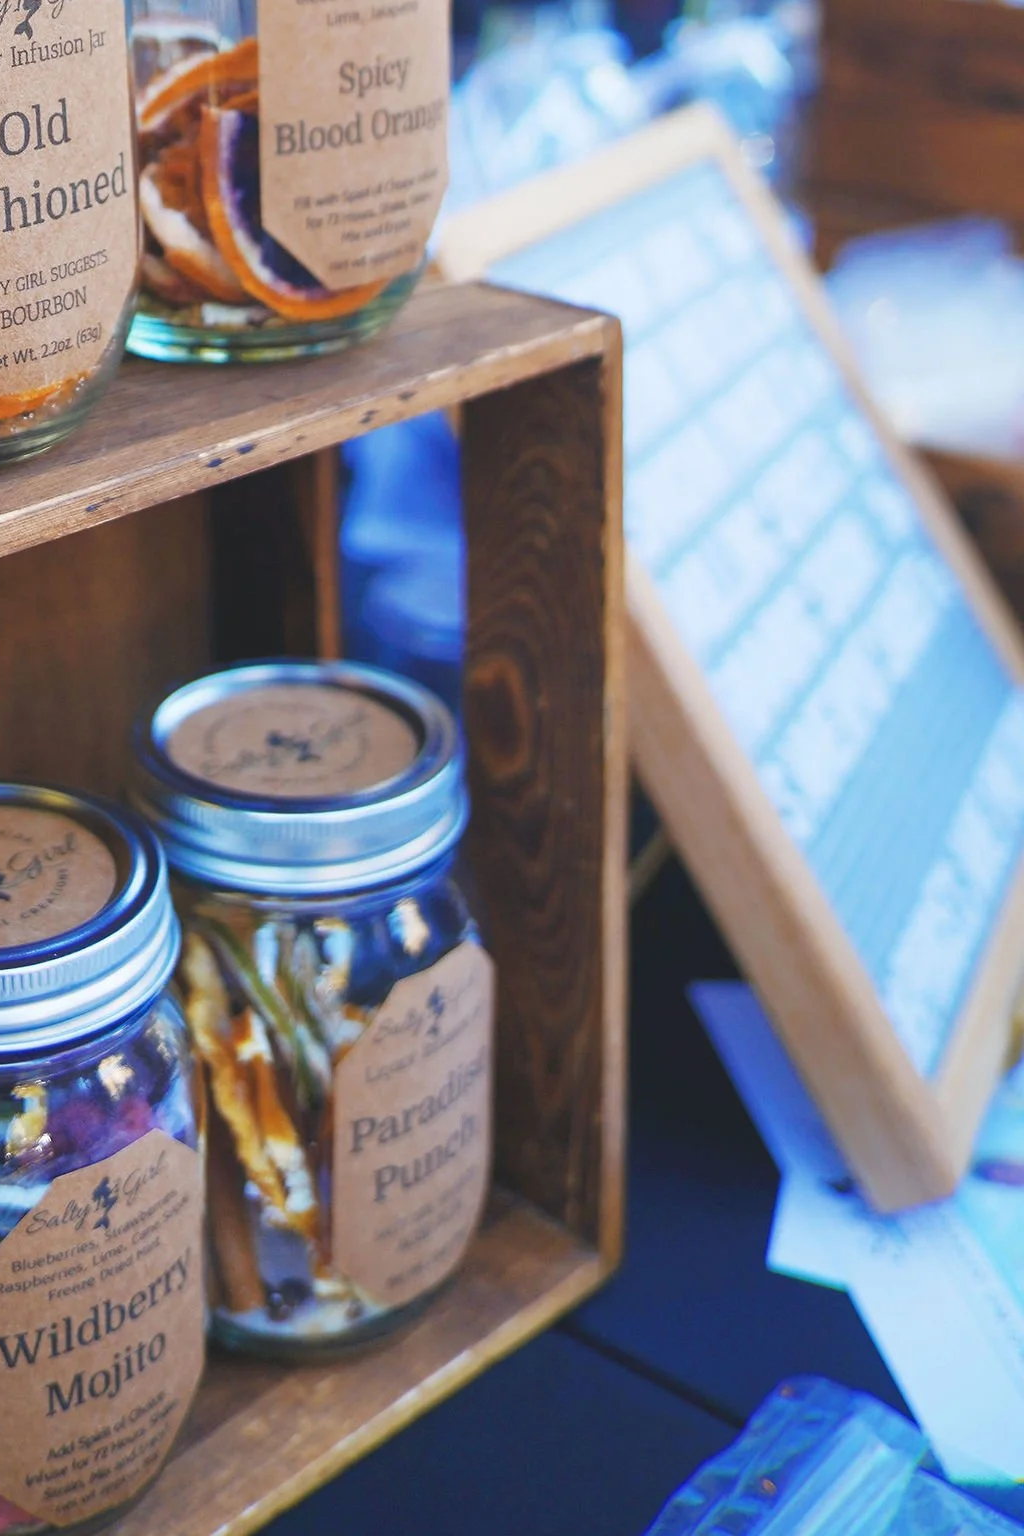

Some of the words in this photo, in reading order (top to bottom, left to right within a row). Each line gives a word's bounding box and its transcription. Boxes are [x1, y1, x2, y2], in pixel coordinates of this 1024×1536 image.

[10, 36, 85, 69] Infusion
[88, 28, 107, 56] Jar
[338, 55, 412, 99] Spicy
[274, 111, 364, 157] Blood
[15, 270, 48, 293] GIRL
[50, 249, 109, 283] SUGGESTS
[0, 286, 88, 331] BOURBON
[12, 347, 38, 365] Wt.
[41, 337, 74, 360] 2.2oz
[76, 322, 103, 349] (63g)
[6, 831, 79, 881] Girl
[374, 1113, 477, 1203] Punch
[26, 1198, 92, 1236] Salty
[122, 1149, 167, 1207] Girl
[11, 1241, 100, 1274] Blueberries,
[47, 1275, 96, 1302] Freeze
[100, 1258, 133, 1281] Dried
[44, 1331, 167, 1418] Mojito
[47, 1441, 76, 1462] Add
[78, 1425, 112, 1451] Spirit
[113, 1415, 127, 1432] of
[71, 1455, 90, 1472] for
